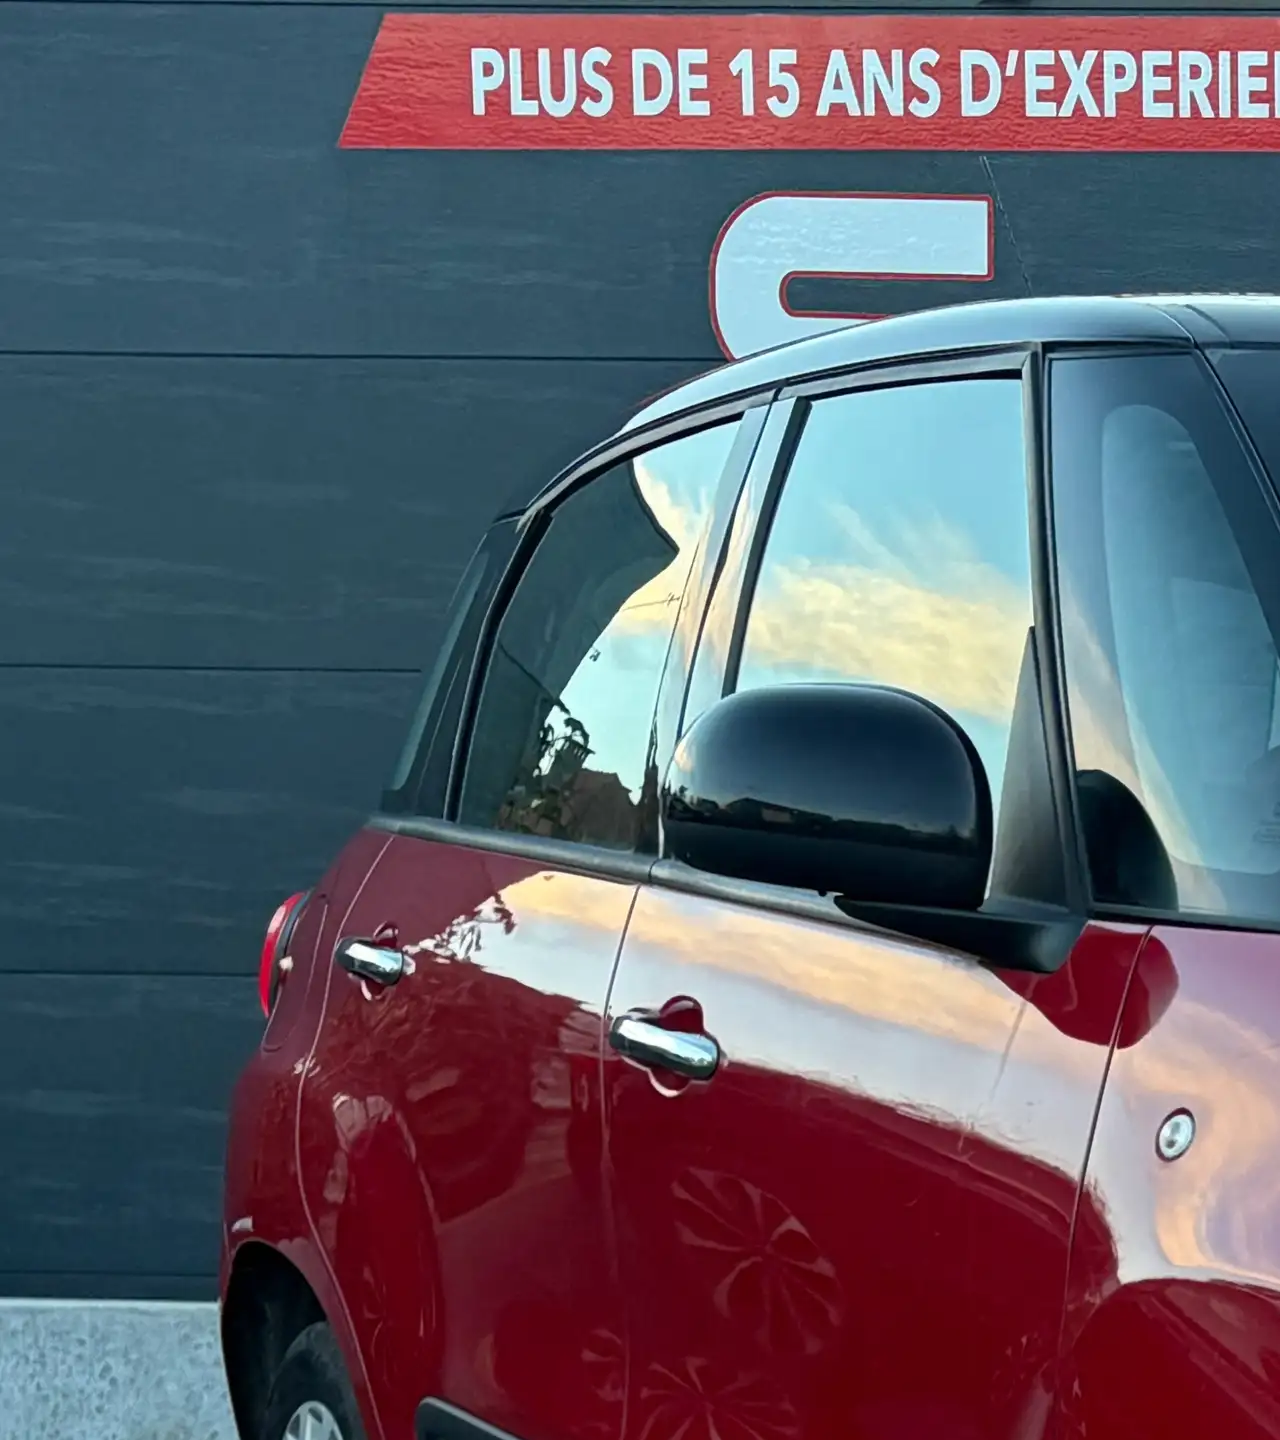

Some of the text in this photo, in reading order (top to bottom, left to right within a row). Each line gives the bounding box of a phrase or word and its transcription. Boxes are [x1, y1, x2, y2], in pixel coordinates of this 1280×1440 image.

[470, 47, 614, 118] PLUS
[632, 48, 712, 117] DE
[728, 48, 801, 118] 15
[816, 48, 942, 118] ANS
